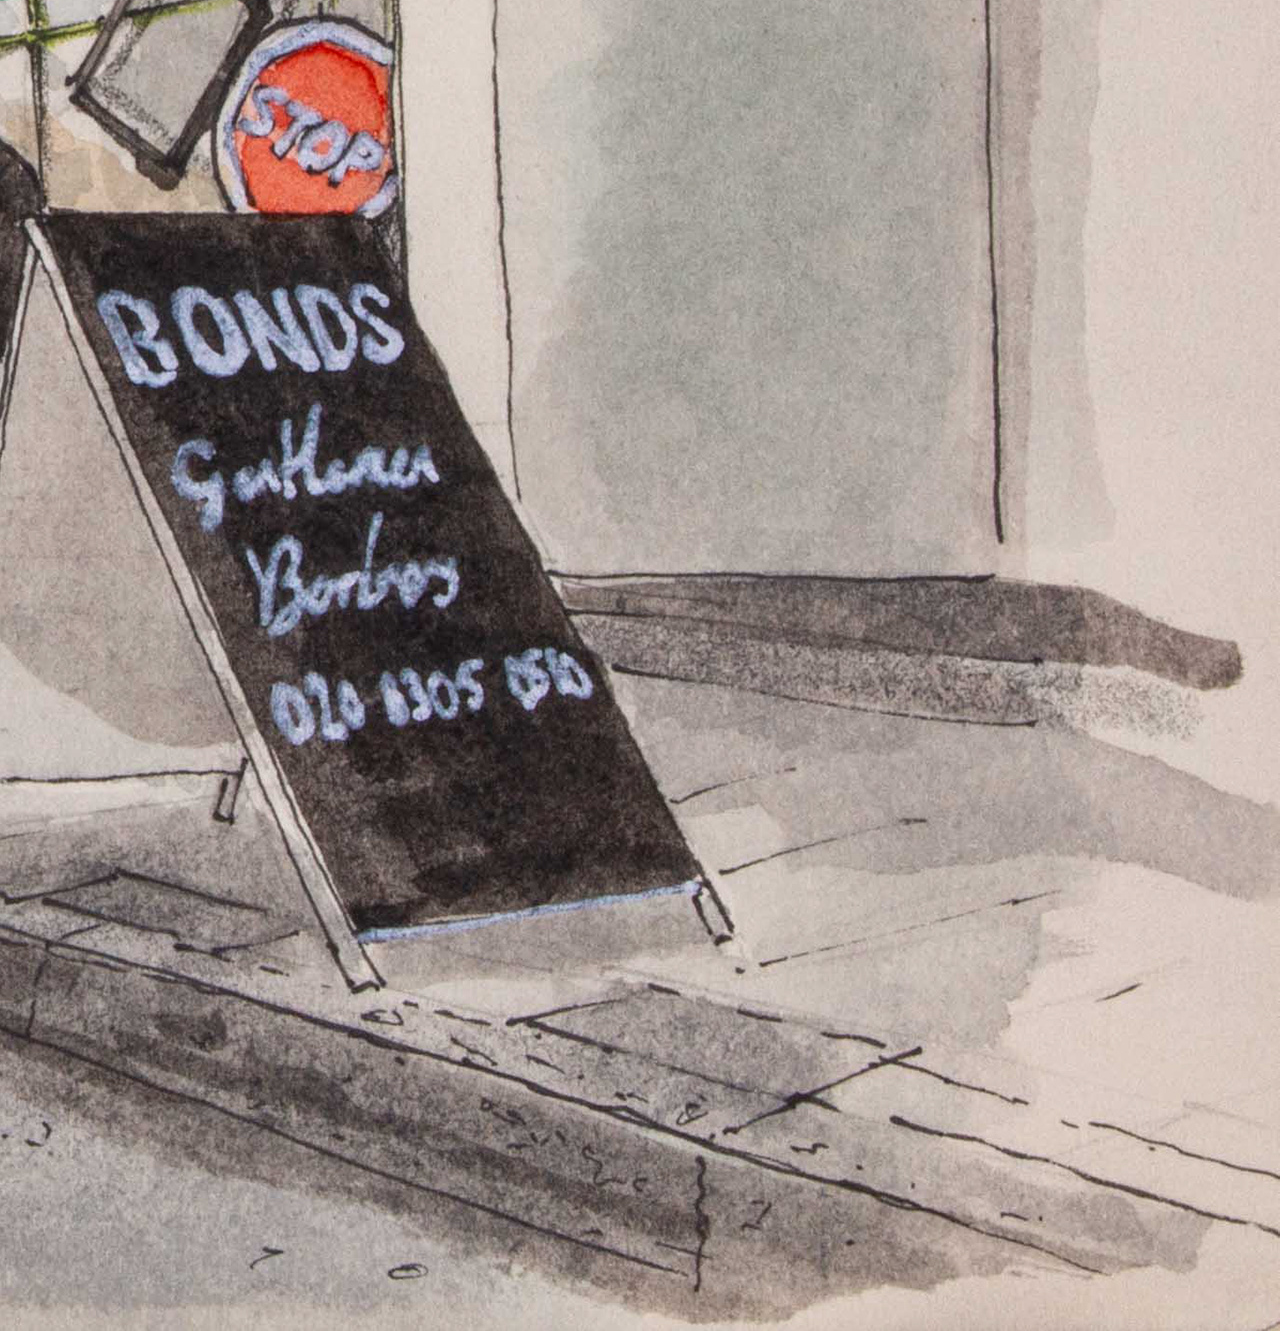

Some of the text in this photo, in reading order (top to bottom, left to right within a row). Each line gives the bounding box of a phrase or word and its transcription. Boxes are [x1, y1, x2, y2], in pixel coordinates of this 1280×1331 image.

[238, 84, 385, 188] STOP
[97, 282, 405, 388] BONDS
[270, 670, 366, 746] 020
